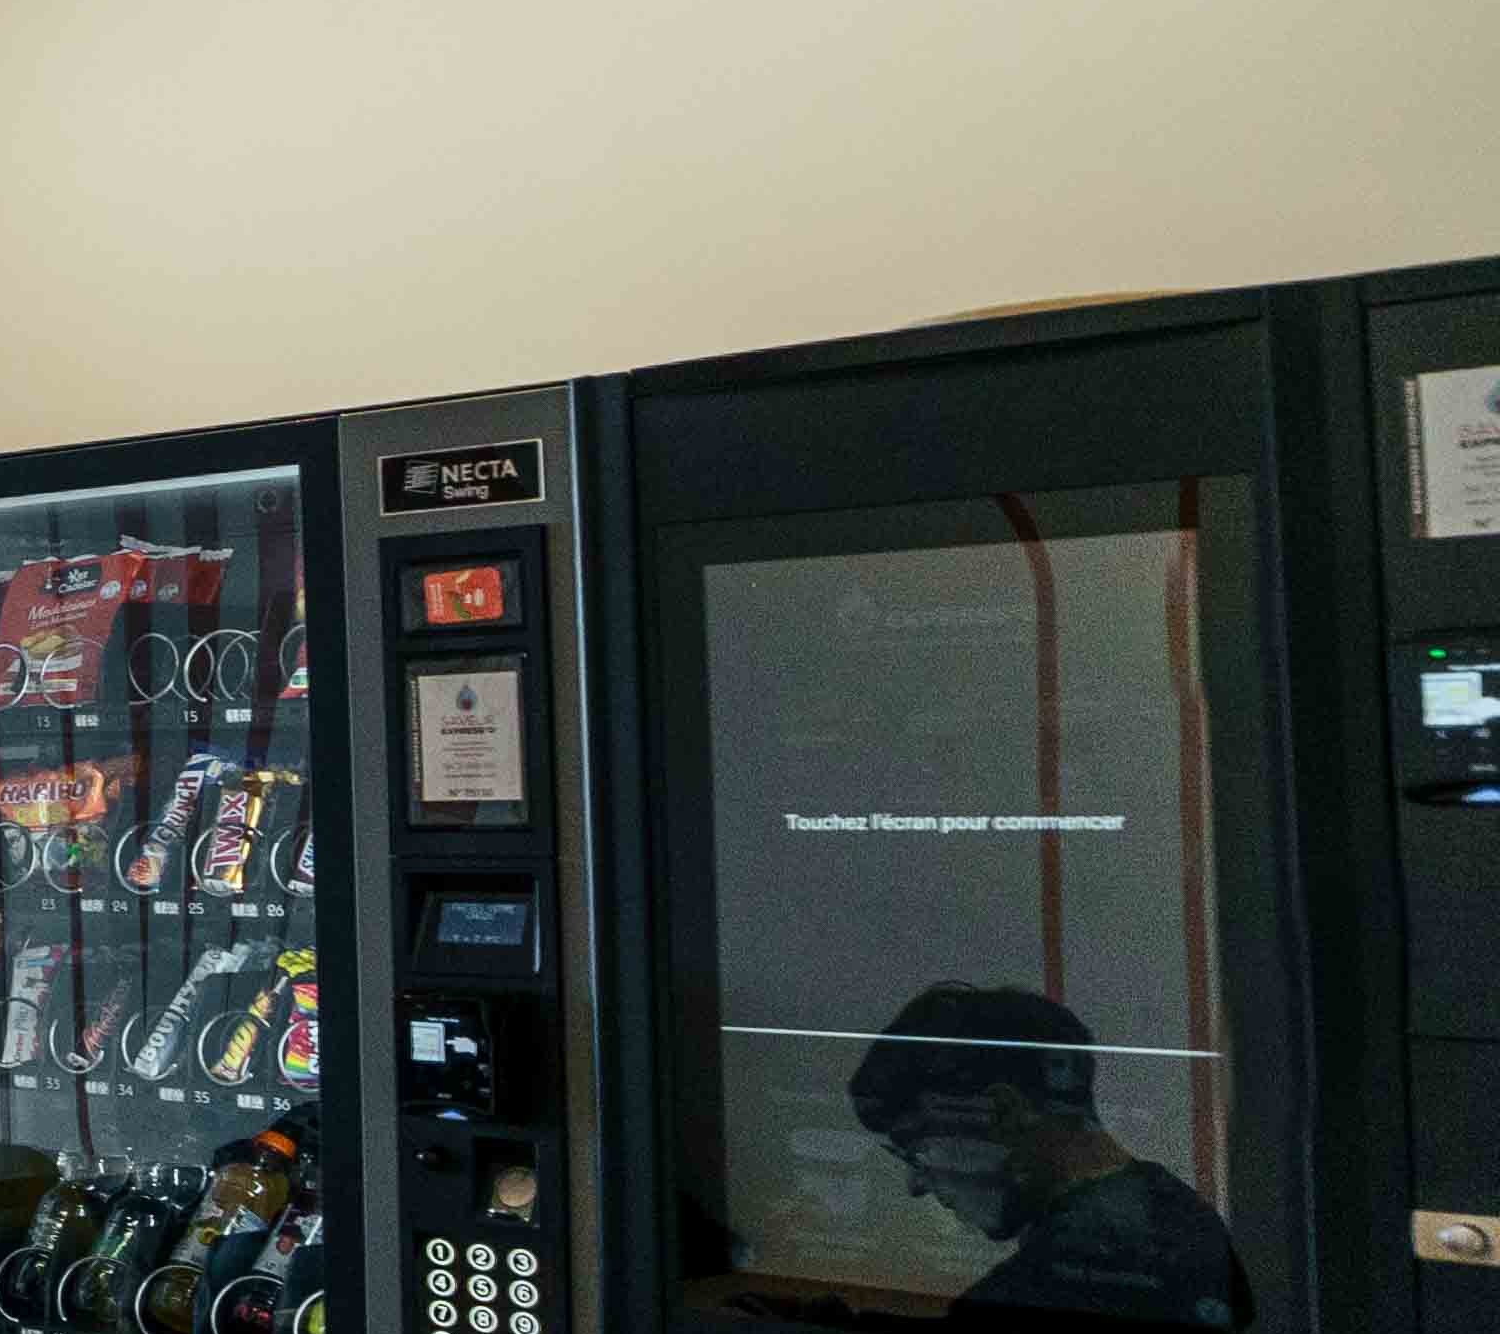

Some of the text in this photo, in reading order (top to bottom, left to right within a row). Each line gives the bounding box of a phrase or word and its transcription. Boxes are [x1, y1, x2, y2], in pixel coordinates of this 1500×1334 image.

[441, 459, 518, 483] NECTA
[184, 710, 198, 723] 15
[0, 781, 86, 804] HARIBO
[204, 792, 248, 876] TWIX
[784, 813, 1125, 834] Touchez l'écran pour commencer
[112, 900, 128, 913] 24
[188, 903, 204, 916] 25
[267, 904, 285, 917] 26
[117, 1084, 133, 1097] 34
[193, 1091, 210, 1104] 35
[273, 1098, 291, 1111] 36
